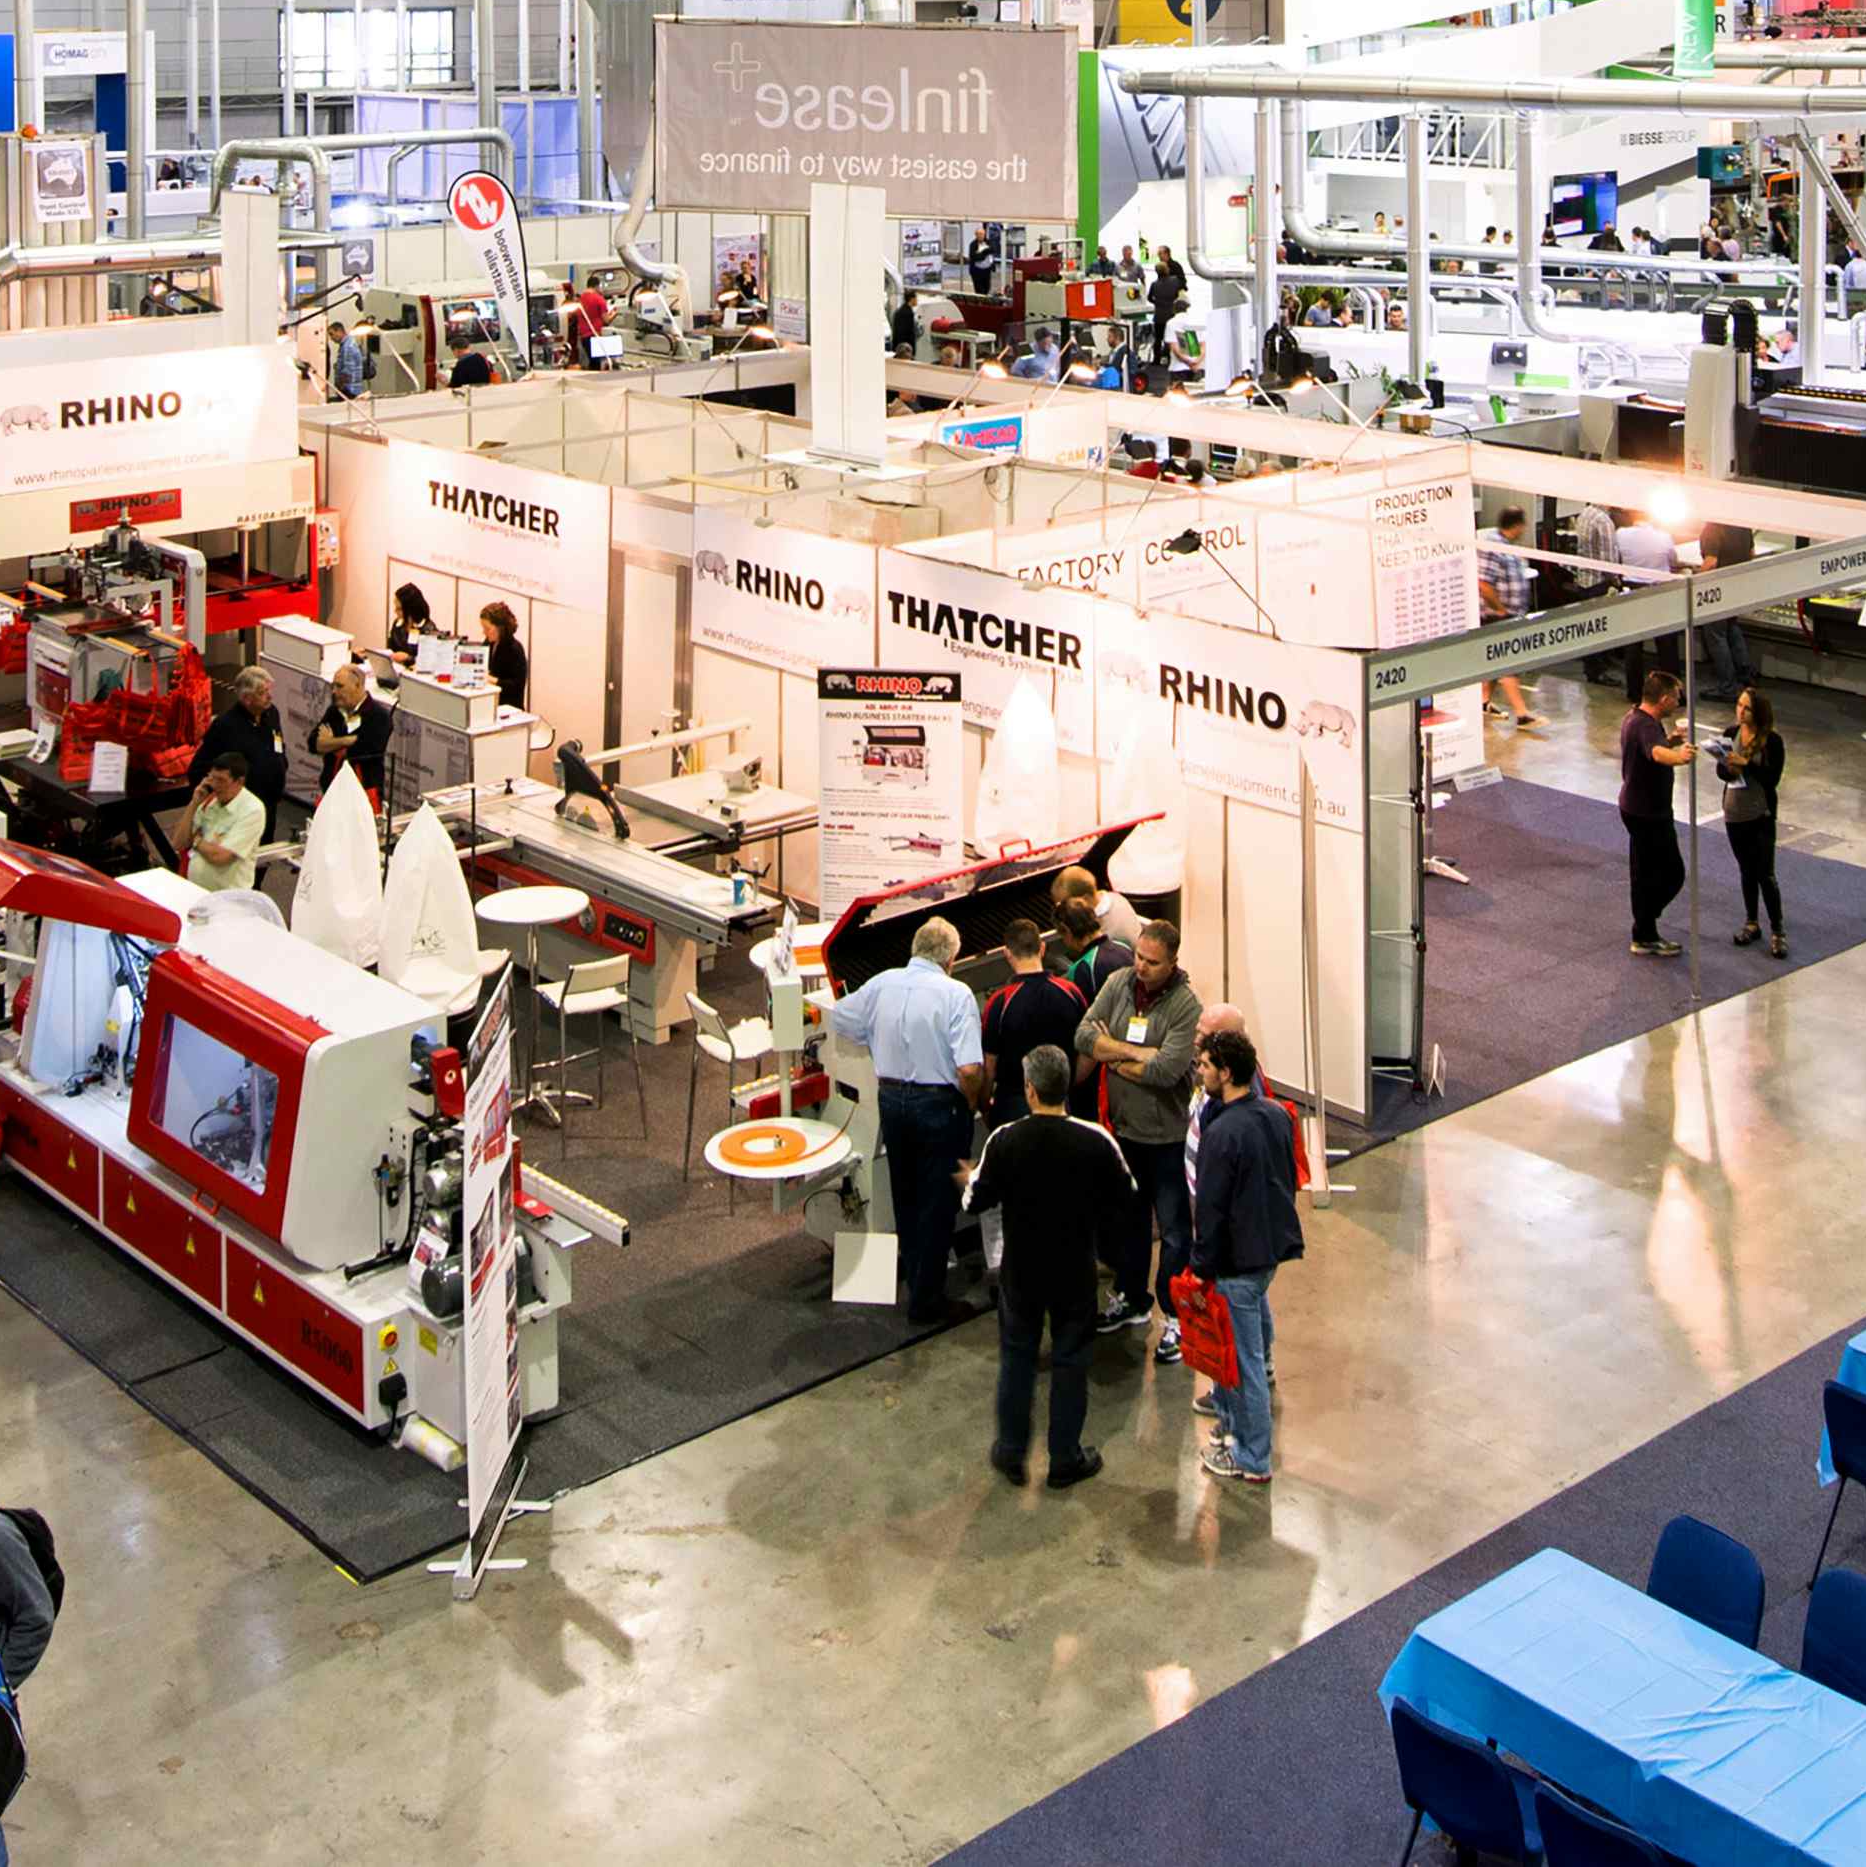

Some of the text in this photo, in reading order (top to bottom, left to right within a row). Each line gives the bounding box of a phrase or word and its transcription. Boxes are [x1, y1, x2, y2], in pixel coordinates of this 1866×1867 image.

[54, 50, 89, 59] HOMAG
[1683, 10, 1699, 64] NEW
[60, 390, 182, 430] RHINO
[428, 479, 560, 538] THATCHER
[1374, 484, 1454, 513] PRODUCTION
[1144, 524, 1247, 565] COROL
[736, 558, 825, 613] RHINO
[1696, 586, 1722, 609] 2420
[887, 590, 1082, 671] THATCHER
[1486, 615, 1608, 662] EMPOWER SOFTWARE
[949, 640, 1006, 668] Engineering
[854, 675, 923, 695] RHINO
[1159, 663, 1287, 731] RHINO
[1375, 665, 1406, 690] 2420
[852, 712, 891, 721] BUSINESS
